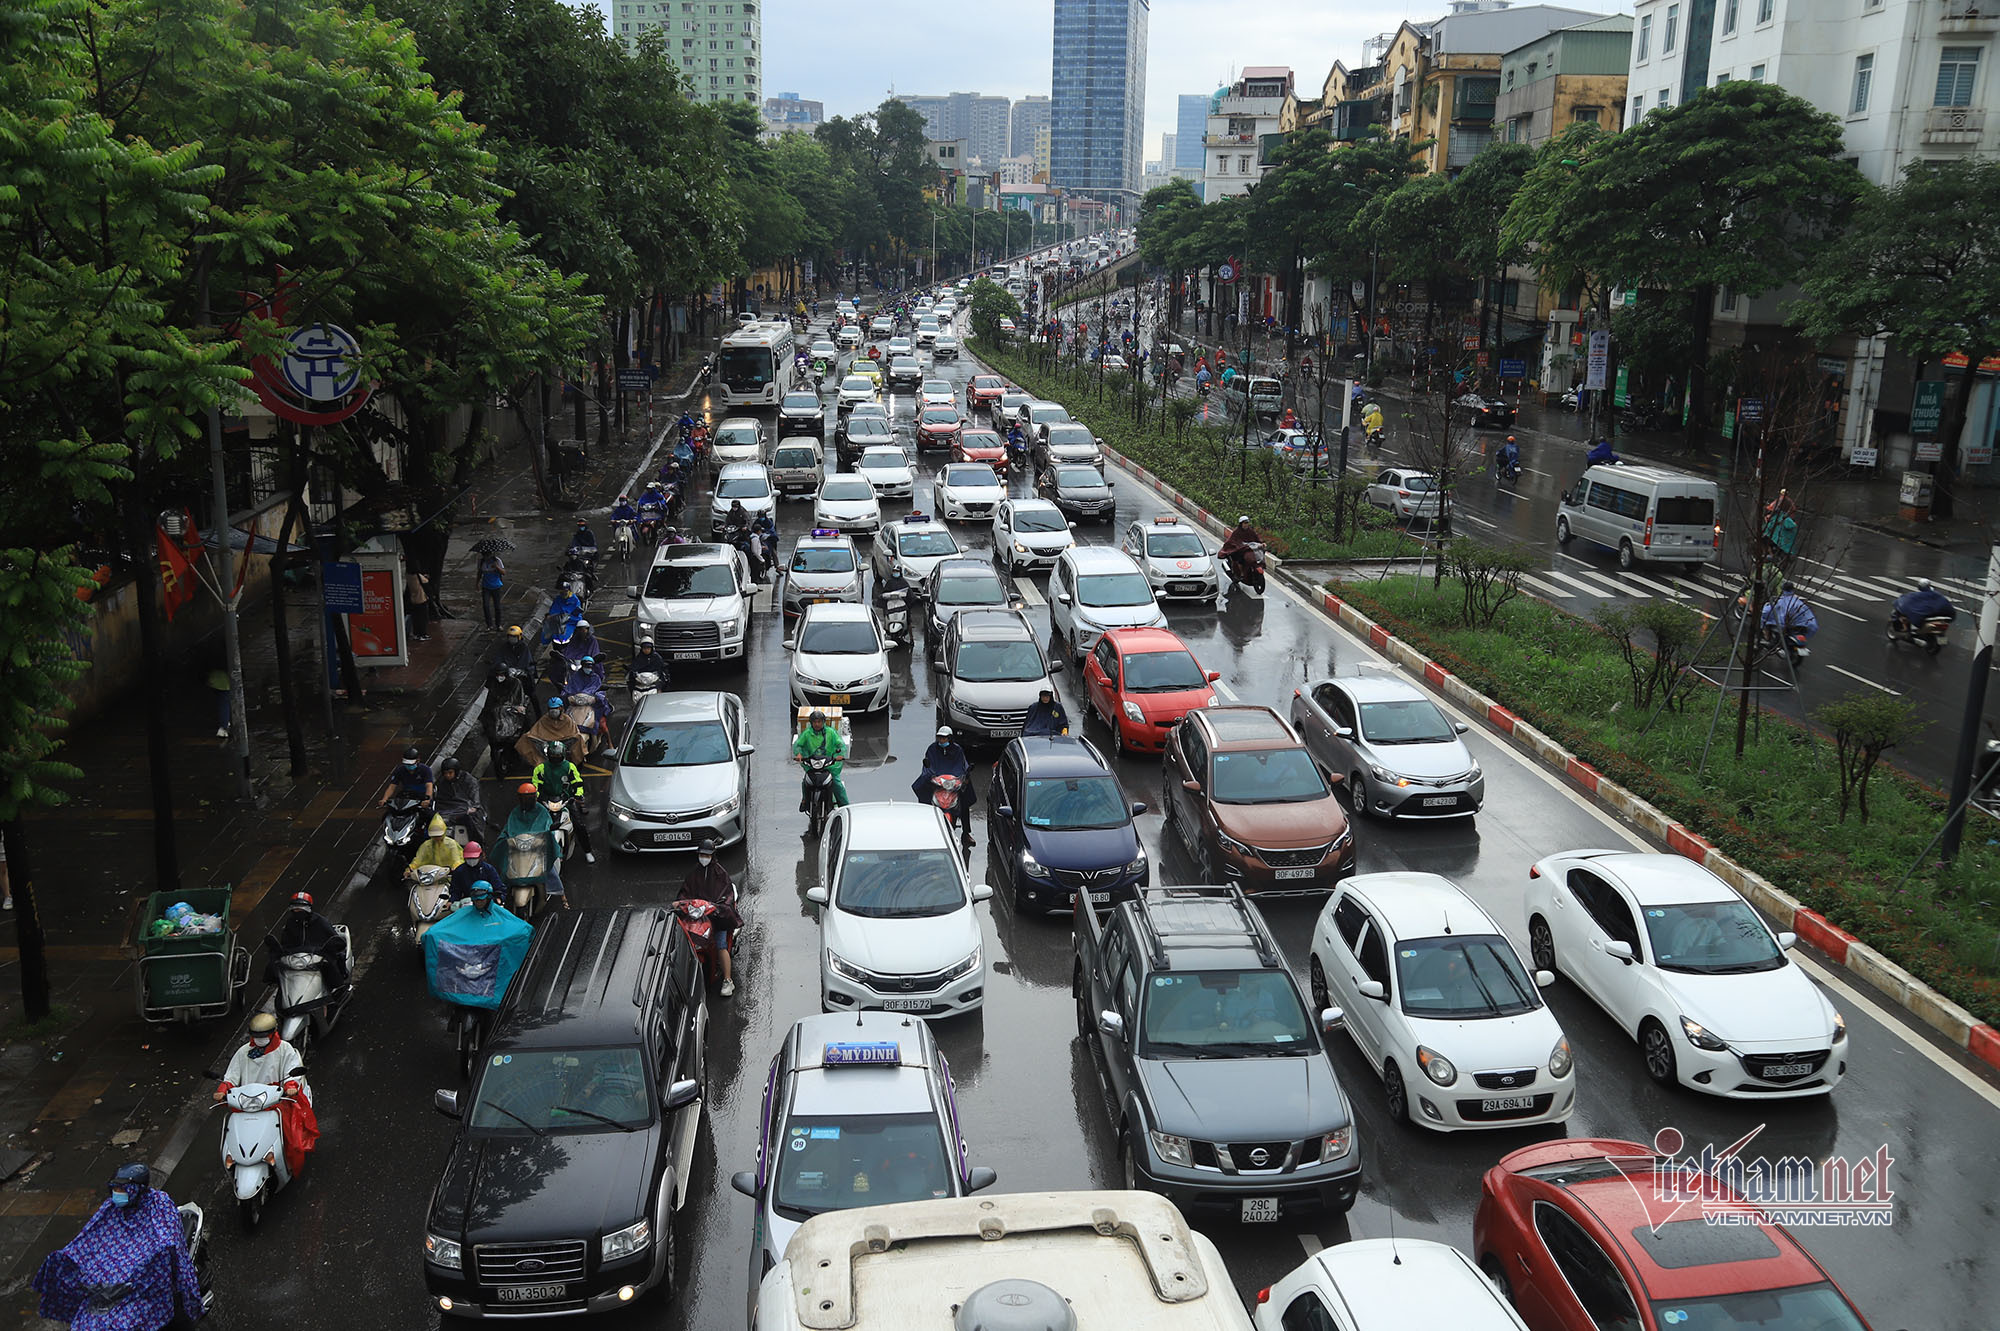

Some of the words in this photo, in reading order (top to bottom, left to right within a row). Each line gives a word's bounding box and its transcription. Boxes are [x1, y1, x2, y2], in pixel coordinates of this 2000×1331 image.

[841, 1047, 862, 1060] MỸ
[863, 1046, 895, 1060] ĐÌNH
[1484, 1097, 1533, 1111] 29A-694.14
[793, 1140, 804, 1148] 99
[1251, 1200, 1270, 1210] 29C
[1243, 1211, 1277, 1222] 240.22
